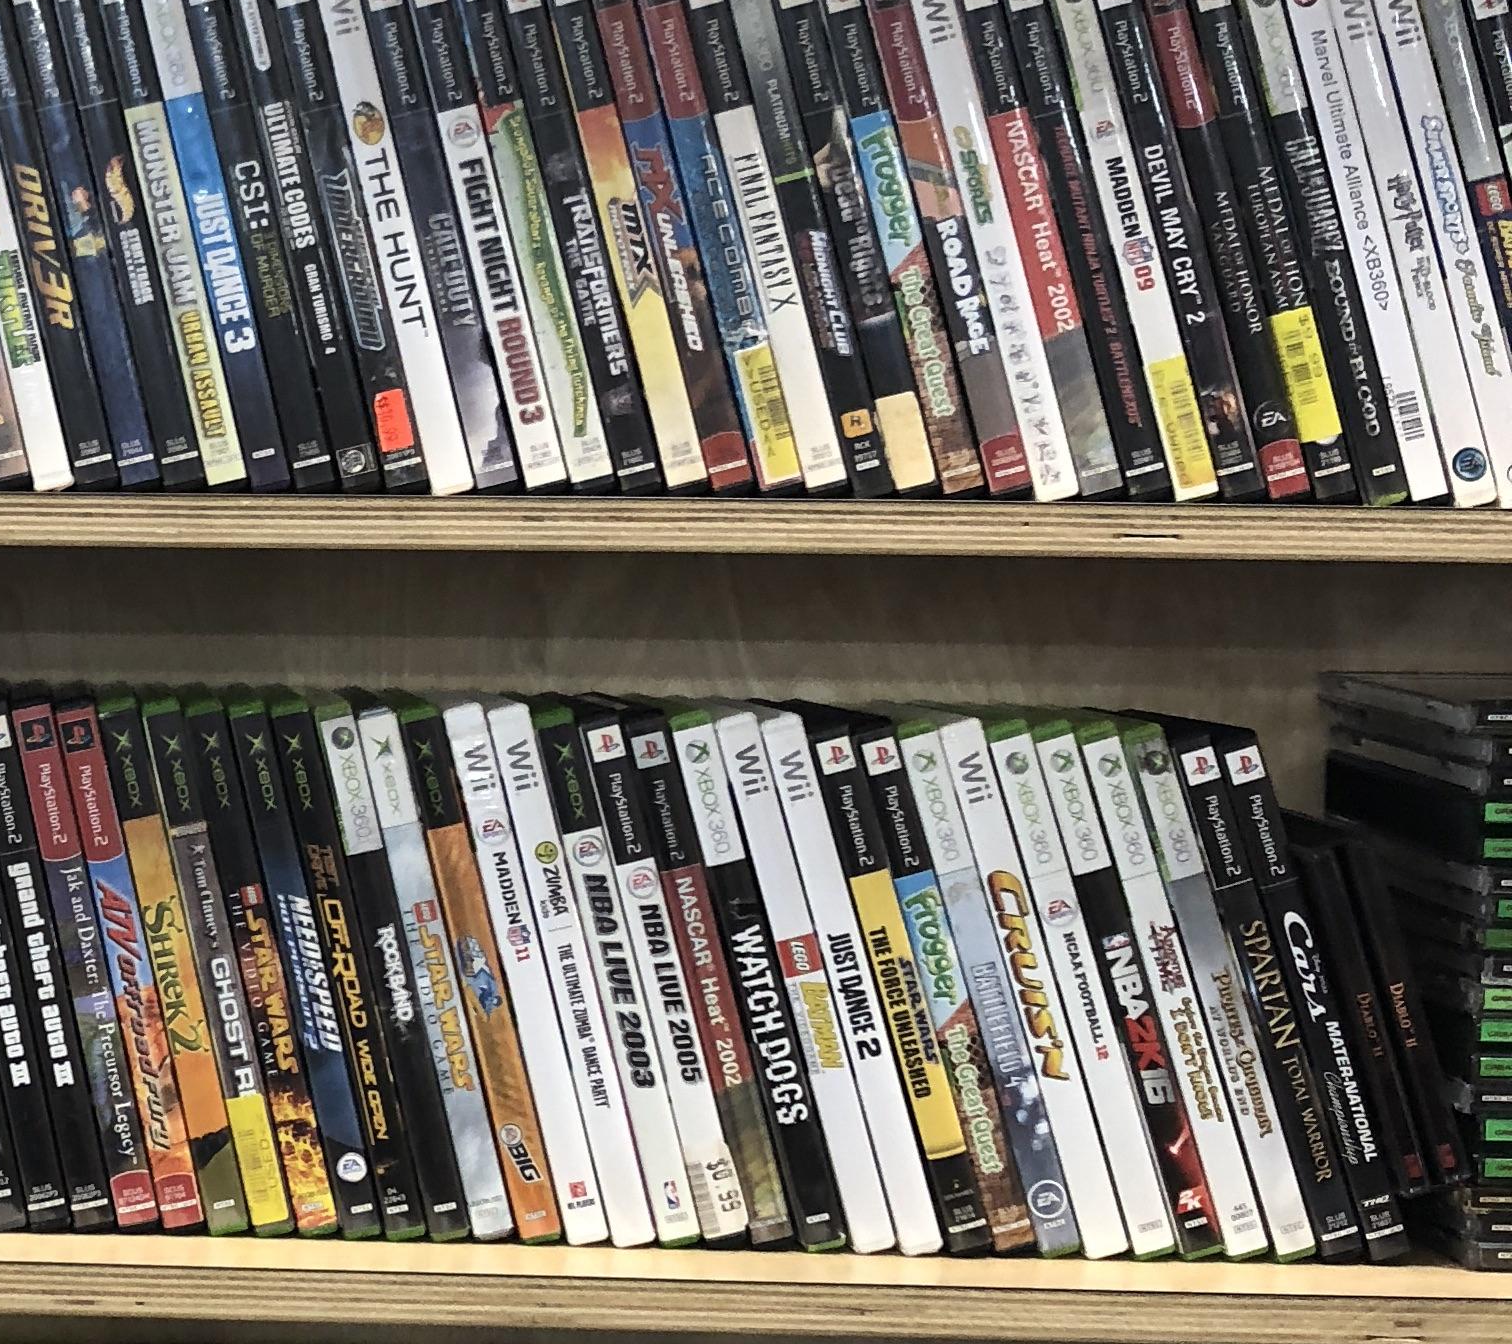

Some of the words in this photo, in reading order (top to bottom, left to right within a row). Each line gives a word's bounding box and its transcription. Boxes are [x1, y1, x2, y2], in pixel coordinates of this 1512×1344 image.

[136, 119, 182, 243] MONSTER
[363, 148, 403, 225] THE
[1143, 144, 1174, 205] DEVIL
[1312, 30, 1337, 86] Marvel
[1326, 90, 1351, 160] Ultimate
[1345, 165, 1370, 230] Alliance
[1358, 236, 1388, 311] <XB360>
[13, 163, 75, 331] DRIV3R
[194, 192, 237, 248] JUST
[1005, 119, 1039, 211] NASCAR
[1026, 221, 1056, 271] Heat
[1045, 283, 1073, 332] 2002
[1106, 156, 1141, 238] MADDEN
[1134, 266, 1155, 292] 09
[1157, 208, 1185, 252] MAY
[160, 248, 200, 305] JAM
[203, 249, 250, 325] DANCE
[380, 232, 425, 332] HUNT
[460, 159, 493, 232] FIGHT
[479, 232, 517, 313] NIGHT
[499, 317, 539, 404] ROUND
[520, 405, 544, 425] 3
[1171, 256, 1197, 296] CRY
[179, 312, 210, 367] URBAN
[224, 330, 256, 353] 3
[1186, 311, 1206, 325] 2
[190, 370, 229, 439] ASSAULT
[8, 862, 40, 926] grand
[61, 867, 81, 891] Jak
[70, 897, 88, 922] and
[25, 932, 51, 999] theft
[75, 927, 102, 984] Daxter:
[582, 874, 616, 933] NBA
[599, 942, 636, 1004] LIVE
[618, 1012, 654, 1088] 2003
[828, 933, 858, 973] JUST
[988, 869, 1070, 1081] CRUIS'N
[41, 1004, 66, 1059] auto
[91, 988, 109, 1019] The
[838, 977, 872, 1034] DANCE
[52, 1060, 73, 1087] III
[97, 1023, 123, 1097] Precursor
[857, 1038, 881, 1061] 2
[1323, 1071, 1359, 1165] Championship
[1327, 1021, 1376, 1163] MATER-NATIONAL
[109, 1101, 135, 1157] Legacy
